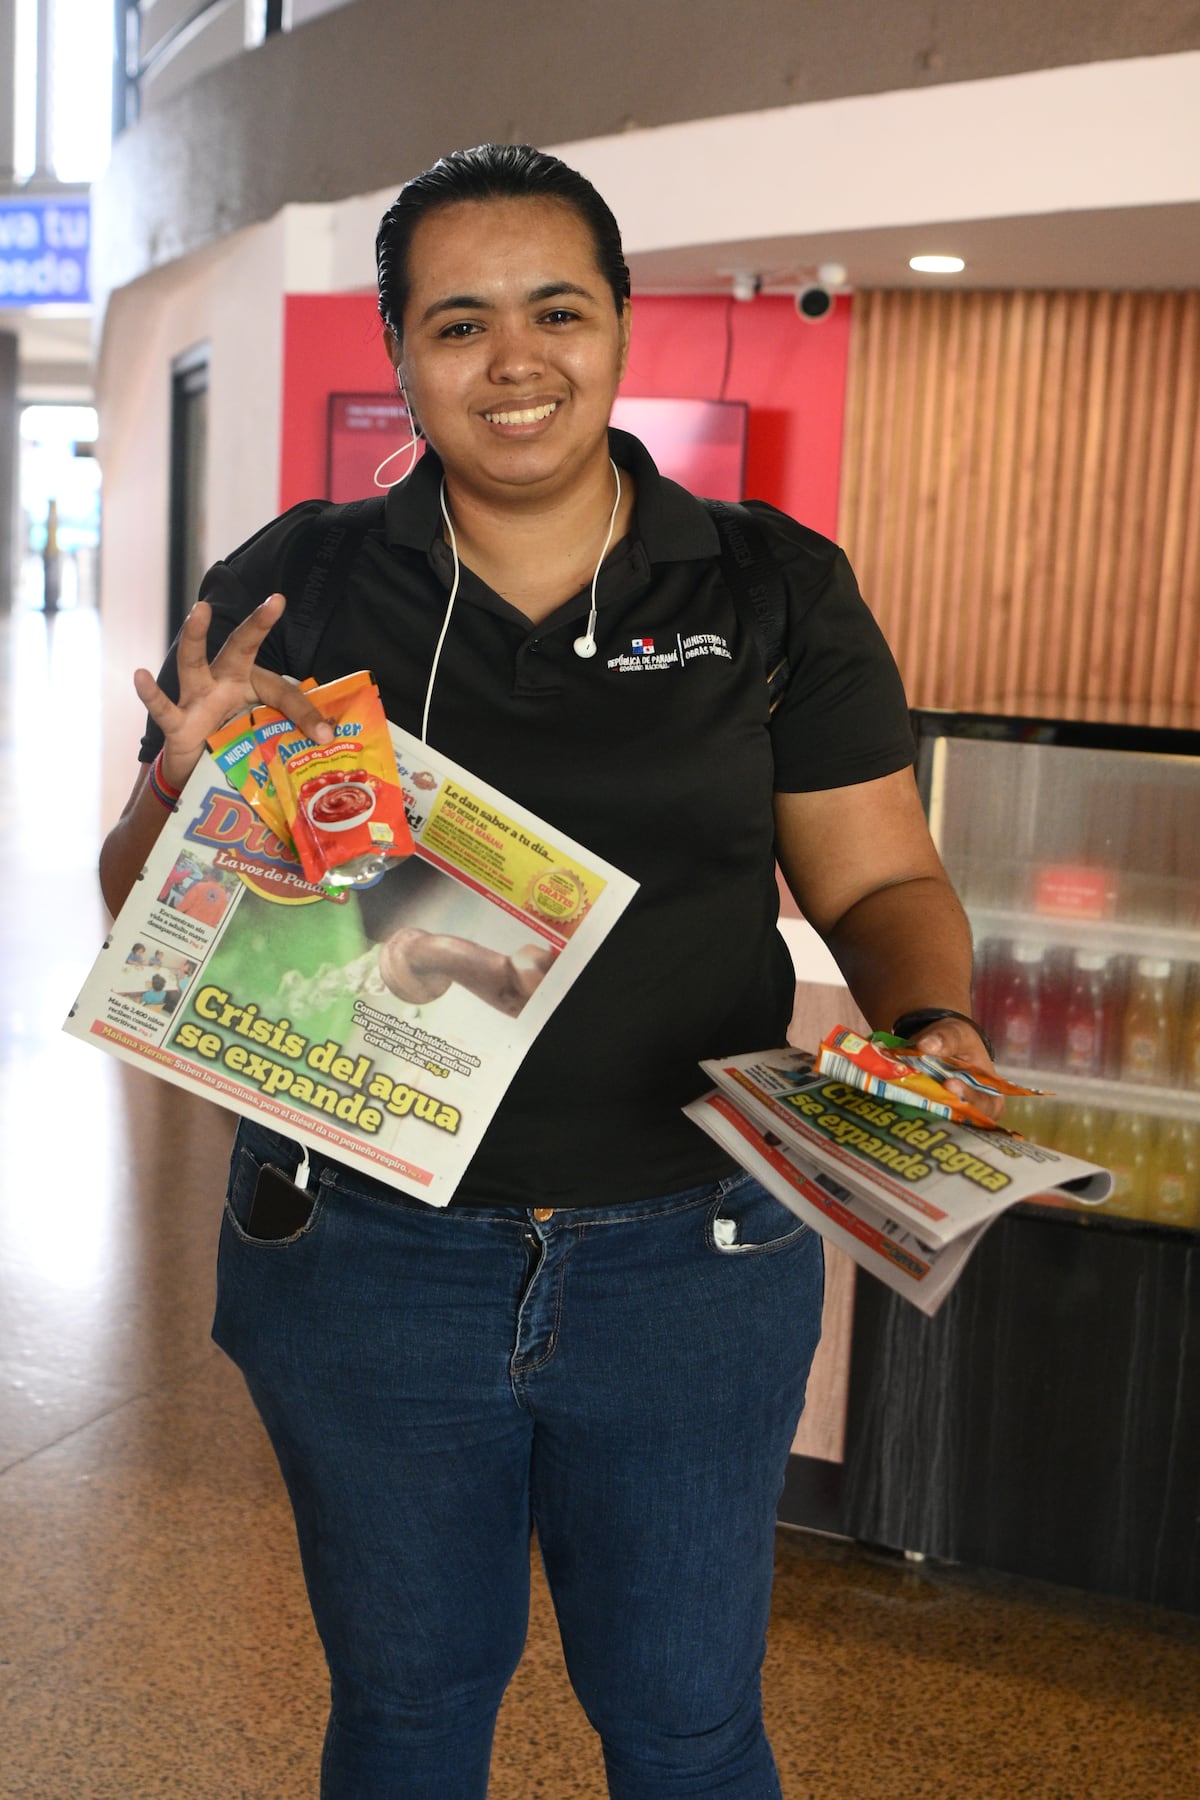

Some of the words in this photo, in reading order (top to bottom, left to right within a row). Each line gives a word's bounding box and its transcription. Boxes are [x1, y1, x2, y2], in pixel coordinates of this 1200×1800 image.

[44, 206, 87, 249] tu
[608, 654, 640, 668] REPÚBLICA
[642, 656, 650, 664] DE
[652, 649, 678, 662] PANAMÁ
[686, 646, 709, 660] OBRAS
[262, 721, 293, 740] NUEVA
[224, 740, 254, 766] NUEVA
[290, 756, 310, 768] Puré
[312, 750, 322, 758] de
[324, 743, 355, 756] Tomate
[440, 806, 455, 818] 5:30
[455, 816, 464, 824] DE
[464, 822, 474, 831] LA
[474, 827, 504, 849] MAÑANA
[443, 800, 456, 810] HOY
[456, 807, 475, 822] DESDE
[475, 820, 487, 830] LAS
[444, 786, 460, 799] Le
[458, 795, 480, 812] dan
[480, 809, 511, 832] sabor
[518, 835, 530, 846] tu
[530, 842, 556, 861] día...
[217, 852, 237, 868] La
[239, 862, 261, 876] voz
[264, 867, 282, 881] de
[538, 882, 573, 908] GRATIS
[147, 919, 189, 943] desaparecido.
[149, 912, 163, 922] vida
[168, 921, 188, 934] adulto
[187, 931, 207, 944] mayor
[159, 908, 194, 928] Encuentran
[195, 925, 205, 933] sin
[106, 1013, 138, 1031] nutritivas.
[108, 997, 121, 1006] Más
[148, 1015, 165, 1026] niños
[108, 1005, 130, 1019] reciben
[131, 1016, 157, 1032] comidas
[353, 1014, 367, 1026] sin
[367, 1022, 414, 1050] problemas
[415, 1043, 441, 1060] ahora
[441, 1056, 470, 1074] sufren
[354, 1001, 415, 1035] Comunidades
[414, 1030, 480, 1066] históricamente
[193, 985, 308, 1058] Crisis
[308, 1040, 369, 1086] del
[367, 1074, 462, 1136] agua
[364, 1033, 392, 1050] cortes
[393, 1046, 426, 1066] diarios.
[177, 1022, 221, 1057] se
[222, 1039, 383, 1137] expande
[102, 1025, 138, 1048] Mañana
[137, 1042, 174, 1065] viernes:
[173, 1059, 202, 1078] Suben
[202, 1073, 216, 1084] las
[215, 1079, 260, 1106] gasolinas,
[259, 1101, 279, 1115] pero
[279, 1109, 289, 1118] el
[289, 1112, 316, 1130] diésel
[315, 1125, 327, 1136] da
[327, 1132, 339, 1142] un
[339, 1136, 376, 1160] pequeño
[375, 1153, 407, 1174] respiro.
[787, 1092, 821, 1117] se
[817, 1104, 931, 1182] expande
[821, 1083, 899, 1128] Crisis
[894, 1114, 937, 1151] del
[937, 1140, 1010, 1193] agua
